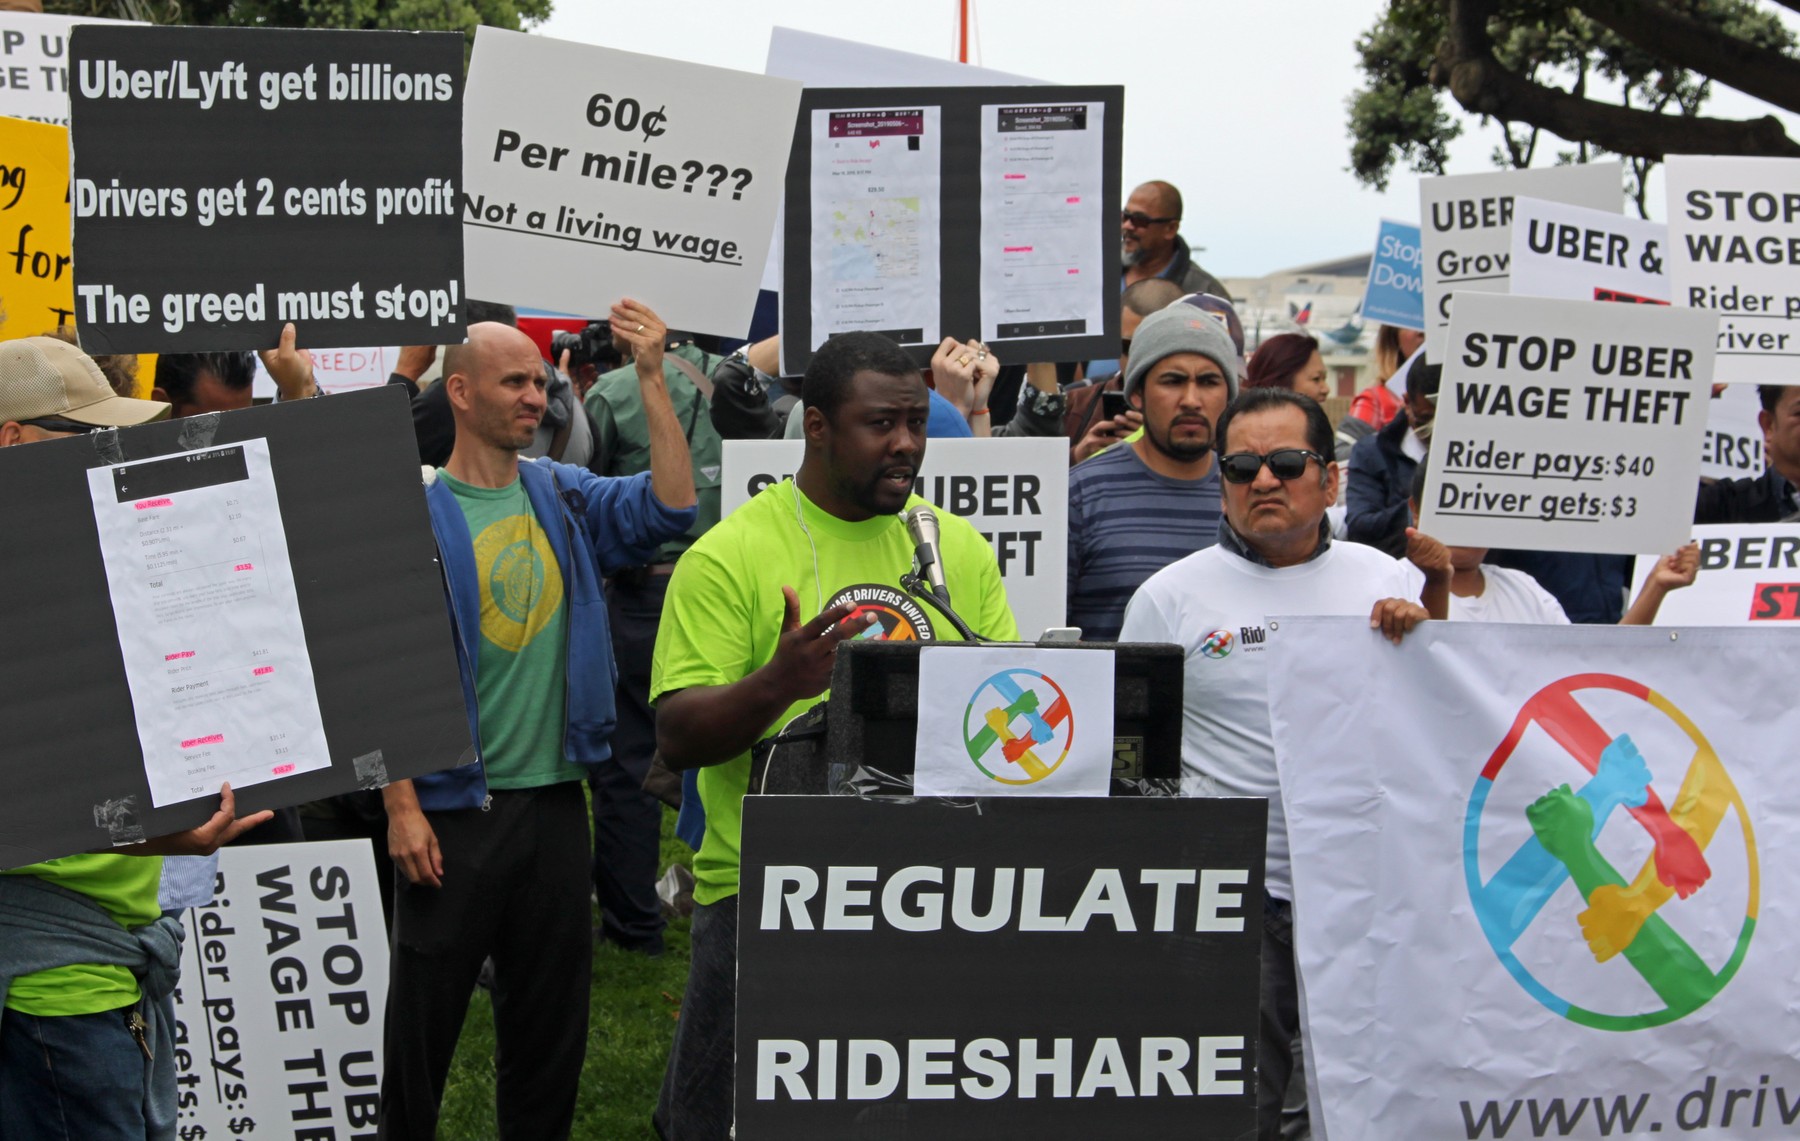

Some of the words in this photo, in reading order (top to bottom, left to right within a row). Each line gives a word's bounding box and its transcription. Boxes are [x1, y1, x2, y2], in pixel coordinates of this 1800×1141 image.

[79, 59, 248, 110] Uber/Lyft
[259, 63, 318, 110] get
[328, 63, 453, 101] billions
[586, 92, 668, 143] 60¢
[493, 129, 570, 172] Per
[580, 150, 754, 201] mile???
[75, 177, 188, 218] Drivers
[197, 180, 247, 227] get
[255, 177, 275, 216] 2
[283, 179, 367, 216] cents
[376, 177, 455, 225] profit
[463, 192, 518, 226] Not
[525, 209, 546, 230] a
[555, 204, 642, 251] living
[652, 229, 743, 264] wage.
[1528, 219, 1629, 269] UBER
[1639, 240, 1665, 276] &
[77, 284, 151, 324] The
[162, 283, 266, 333] greed
[277, 281, 365, 321] must
[375, 279, 459, 327] stop!
[1688, 285, 1774, 312] Rider
[1461, 332, 1577, 373] STOP
[1591, 343, 1694, 380] UBER
[1455, 381, 1571, 420] WAGE
[1583, 385, 1691, 426] THEFT
[1445, 439, 1525, 471] Rider
[1437, 482, 1532, 513] Driver
[149, 580, 164, 590] Total
[853, 588, 903, 606] DRIVERS
[900, 600, 931, 641] UNITED
[165, 652, 181, 661] Rider
[182, 650, 196, 658] Pays
[172, 685, 185, 694] Rider
[186, 680, 209, 692] Payment
[182, 740, 197, 748] Uber
[198, 733, 224, 744] Receives
[190, 786, 204, 794] Total
[759, 865, 1250, 933] REGULATE
[256, 864, 315, 1033] WAGE
[309, 865, 370, 1026] STOP
[755, 1035, 1246, 1100] RIDESHARE
